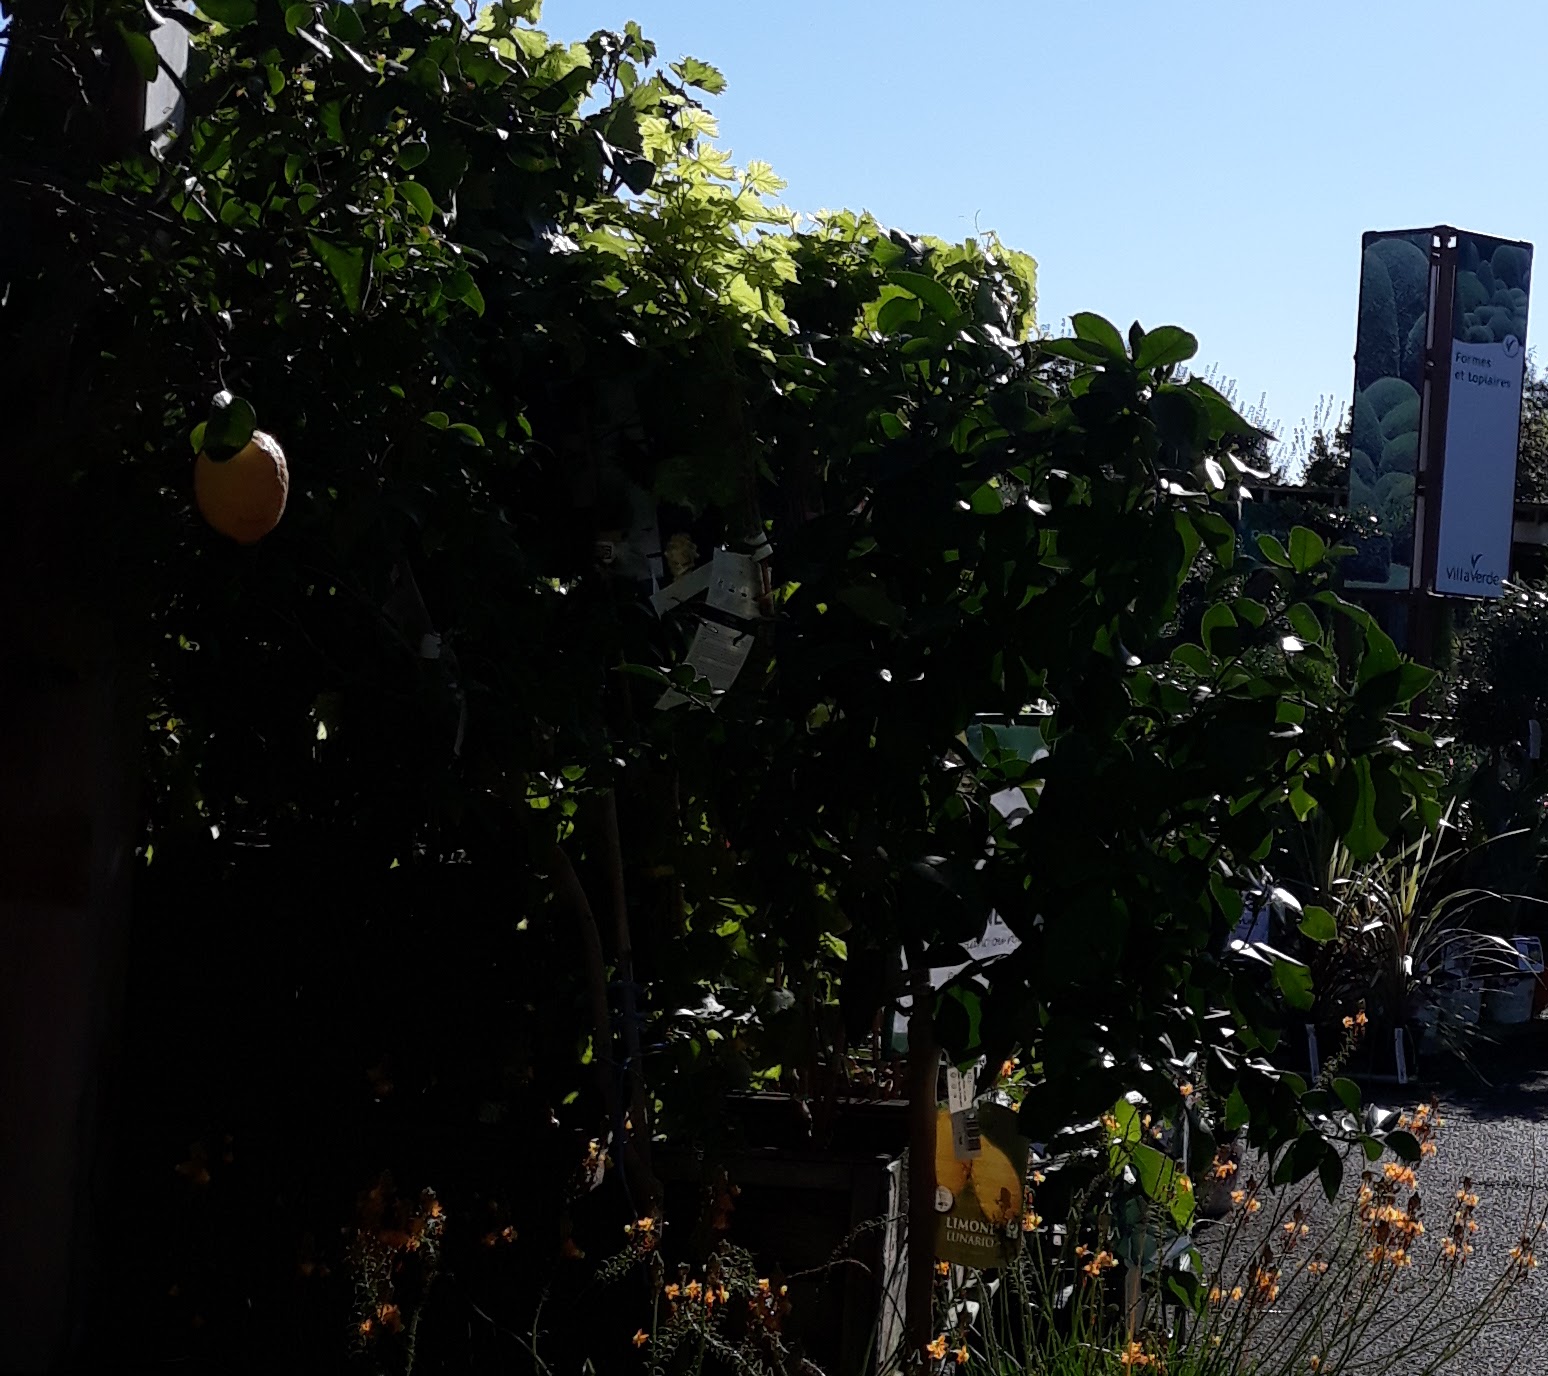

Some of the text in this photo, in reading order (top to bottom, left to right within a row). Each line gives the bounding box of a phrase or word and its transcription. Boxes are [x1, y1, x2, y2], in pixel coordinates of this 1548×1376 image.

[1455, 352, 1492, 367] Formes
[1454, 371, 1511, 388] et topiaires
[1446, 566, 1500, 586] VillaVerde
[946, 1230, 994, 1248] LUNARIO
